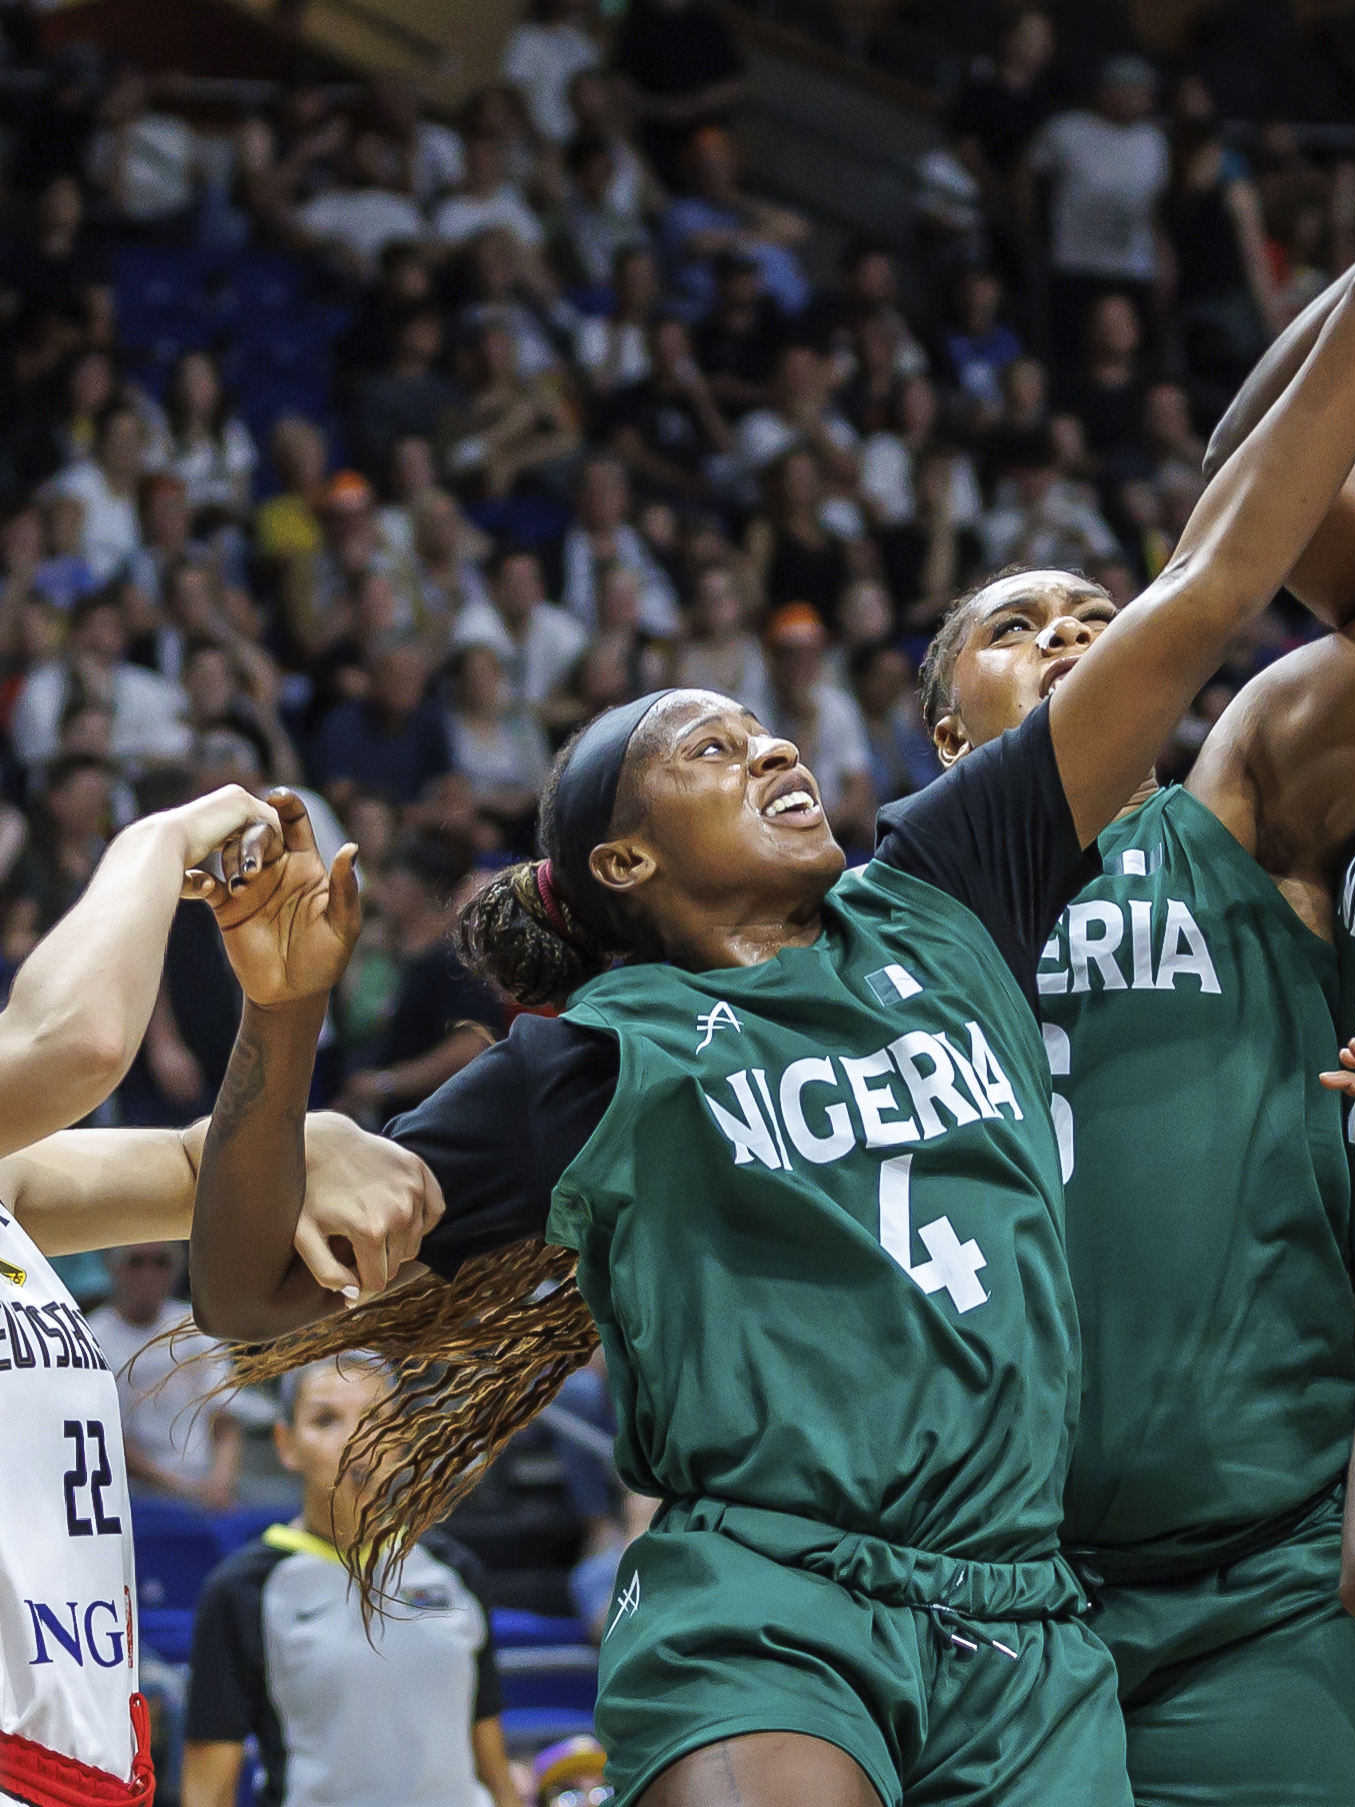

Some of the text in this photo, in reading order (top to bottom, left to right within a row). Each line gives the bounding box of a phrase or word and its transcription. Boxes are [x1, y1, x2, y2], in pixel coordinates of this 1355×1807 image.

[704, 1020, 1024, 1171] NIGERIA
[879, 1153, 988, 1315] 4
[63, 1419, 123, 1537] 22
